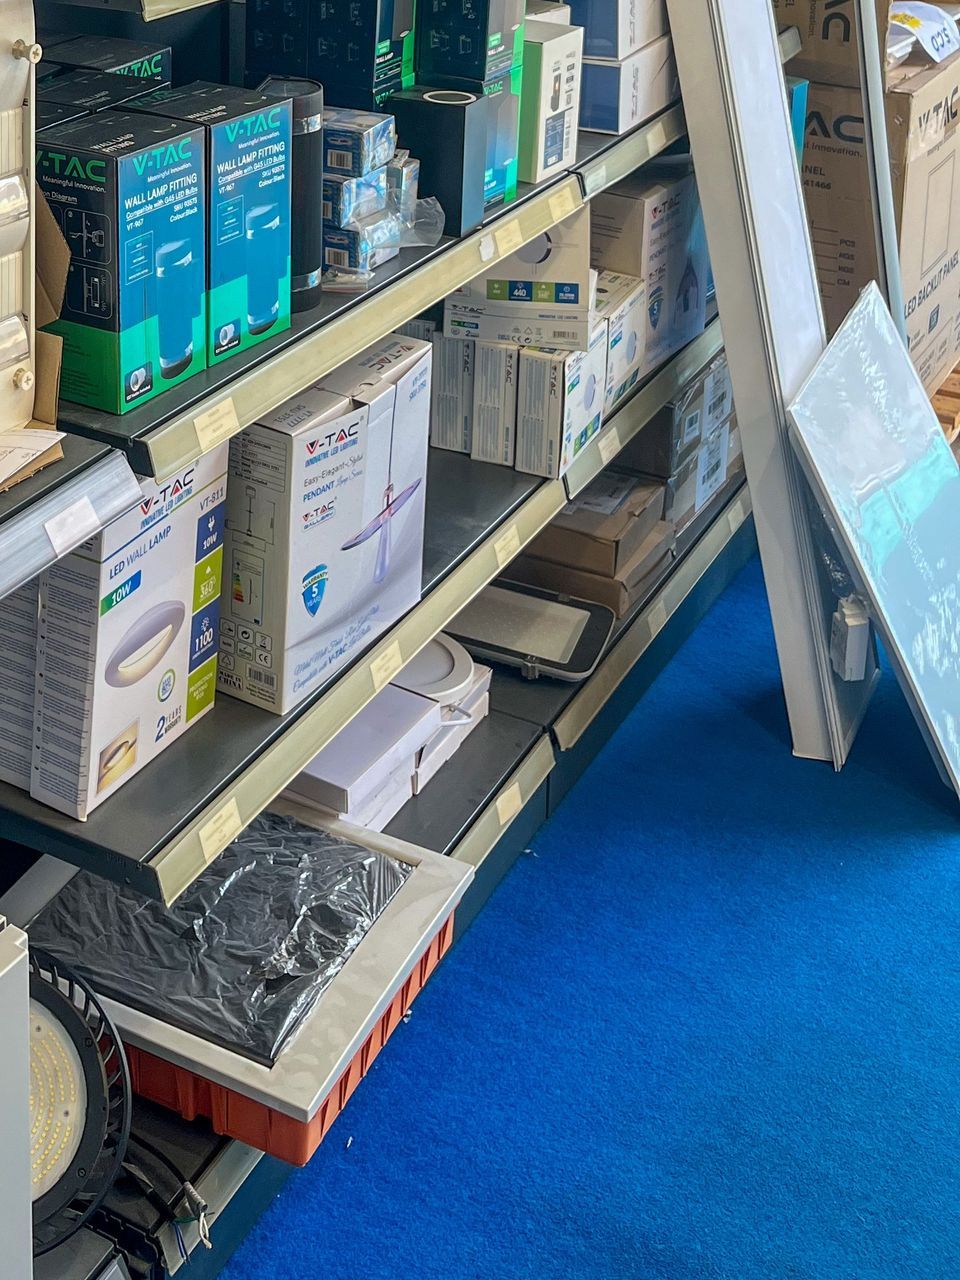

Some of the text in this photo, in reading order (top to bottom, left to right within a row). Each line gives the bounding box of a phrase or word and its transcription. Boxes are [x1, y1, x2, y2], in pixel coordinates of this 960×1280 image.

[224, 108, 282, 144] V-TAC
[132, 137, 192, 176] V-TAC
[216, 141, 286, 174] WALL LAMP FITTING
[811, 143, 863, 158] Innovation.
[42, 174, 107, 193] Meaningful Innovation.
[258, 173, 285, 188] Colour:Black
[261, 169, 272, 179] SKU
[124, 173, 198, 210] WALL LAMP FITTING
[513, 287, 527, 298] 440
[904, 252, 960, 320] LED BACKLIT PANEL
[305, 422, 359, 455] V-TAC
[140, 468, 195, 516] V-TAC
[199, 486, 225, 512] VT-811
[302, 481, 335, 503] PENDANT
[141, 486, 193, 529] INNOVATIVE LED LIGHTING
[302, 500, 335, 522] V-TAC
[109, 525, 172, 580] LED WALL LAMP
[203, 533, 218, 550] 10W
[302, 571, 328, 589] WARRANTY
[311, 583, 319, 598] 5
[111, 580, 132, 607] 10W
[195, 628, 214, 651] 1100
